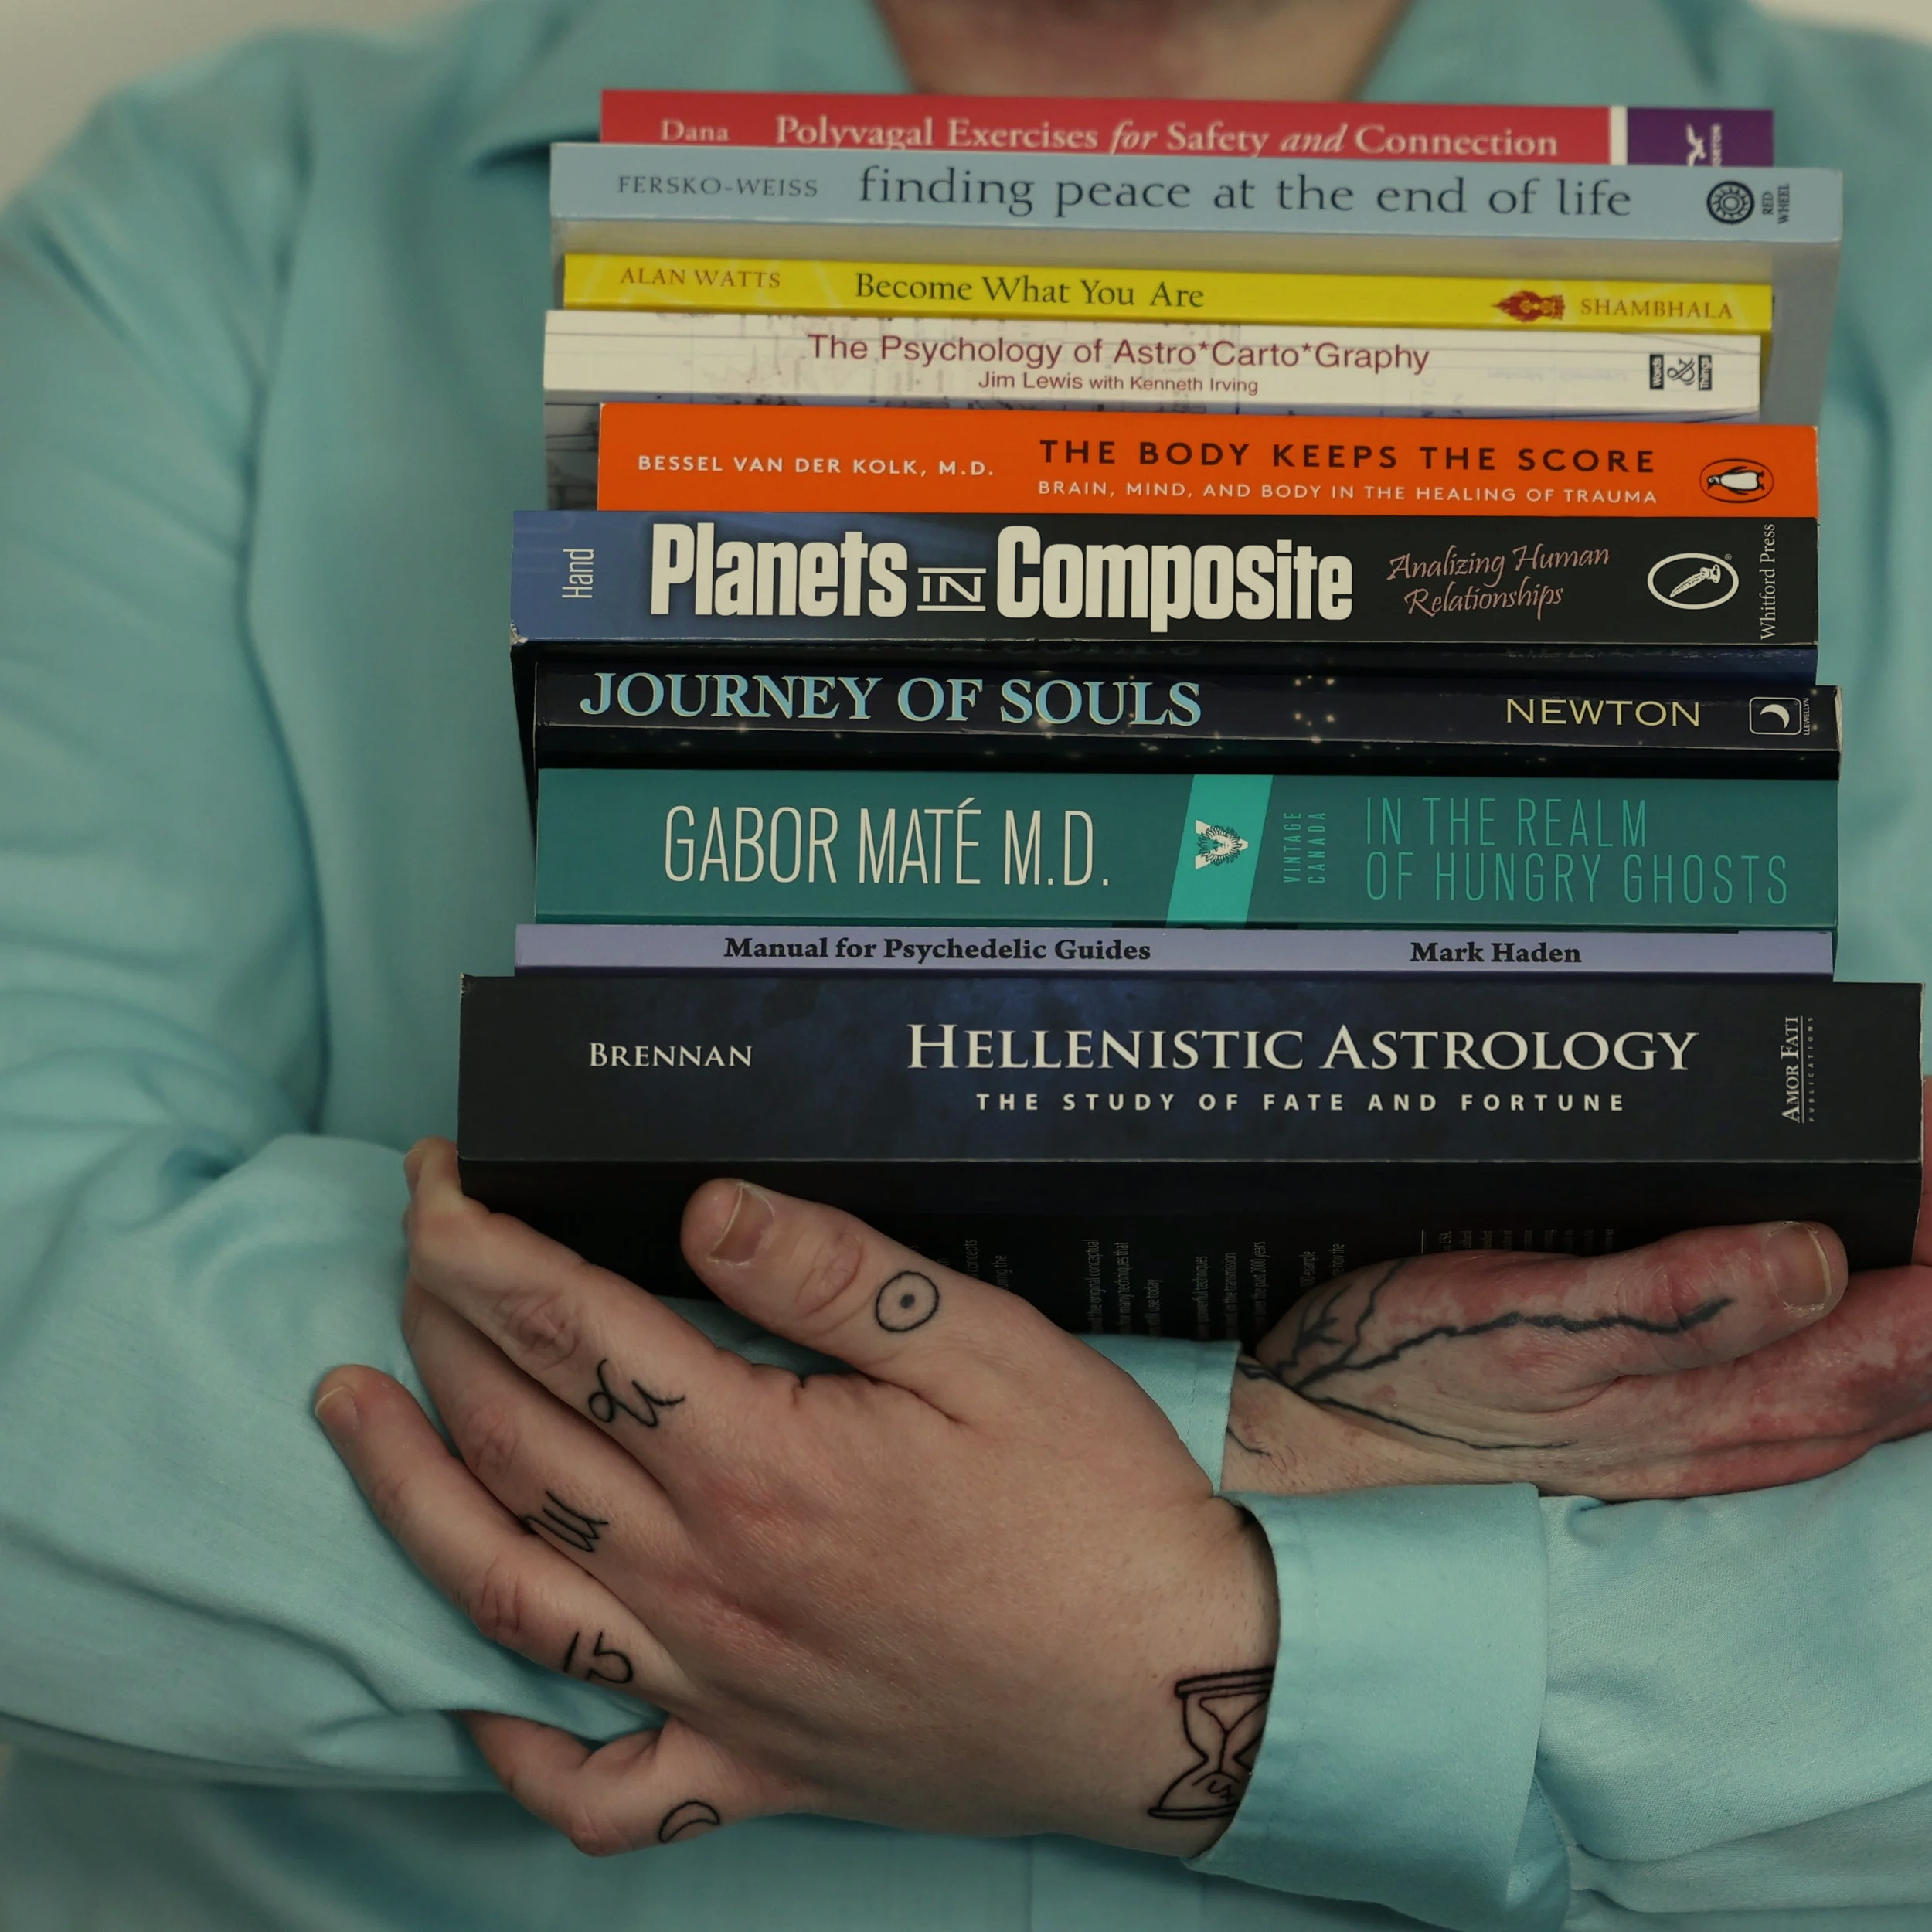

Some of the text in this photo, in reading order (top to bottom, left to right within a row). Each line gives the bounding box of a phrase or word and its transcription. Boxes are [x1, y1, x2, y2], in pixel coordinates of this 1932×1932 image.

[660, 118, 729, 142] Dana
[775, 116, 1556, 157] Polyvagal Exercises for Safety and Connection
[1710, 123, 1723, 166] ORTON
[619, 175, 818, 198] FERSKO-WEISS
[859, 165, 1630, 217] finding peace at the end of life
[1762, 192, 1774, 215] RED
[1777, 184, 1790, 224] WHEEL
[621, 267, 780, 287] ALAN WATTS
[857, 273, 1203, 307] Become What You Are
[1581, 299, 1732, 318] SHAMBHALA
[808, 334, 867, 359] The
[882, 335, 1062, 369] Psychology
[1074, 338, 1102, 363] of
[979, 371, 1257, 396] Jim Lewis with Kenneth Irving
[1652, 357, 1662, 387] Words
[639, 456, 992, 476] BESSEL VAN DER KOLK, M.D.
[1040, 440, 1653, 472] THE BODY KEEPS THE SCORE
[1039, 481, 1656, 503] BRAIN, MIND, AND BODY IN THE HEALING OF TRAUMA
[562, 549, 594, 597] Hand
[651, 523, 1352, 632] Planets IN Composite
[1387, 543, 1610, 587] Analizing Human
[1759, 524, 1777, 640] Whitford Press
[1404, 577, 1564, 620] Relationships
[580, 673, 1201, 726] JOURNEY OF SOULS
[1507, 699, 1699, 726] NEWTON
[1367, 798, 1645, 847] IN THE REALM
[665, 798, 1108, 885] GABOR MATÉ M.D.
[1284, 813, 1301, 883] VINTAGE
[1308, 813, 1325, 883] CANADA
[1367, 852, 1786, 904] OF HUNGRY GHOSTS
[724, 937, 1150, 964] Manual for Psychedelic Guides
[1410, 942, 1582, 962] Mark Haden
[977, 1094, 1622, 1111] THE STUDY OF FATE AND FORTUNE
